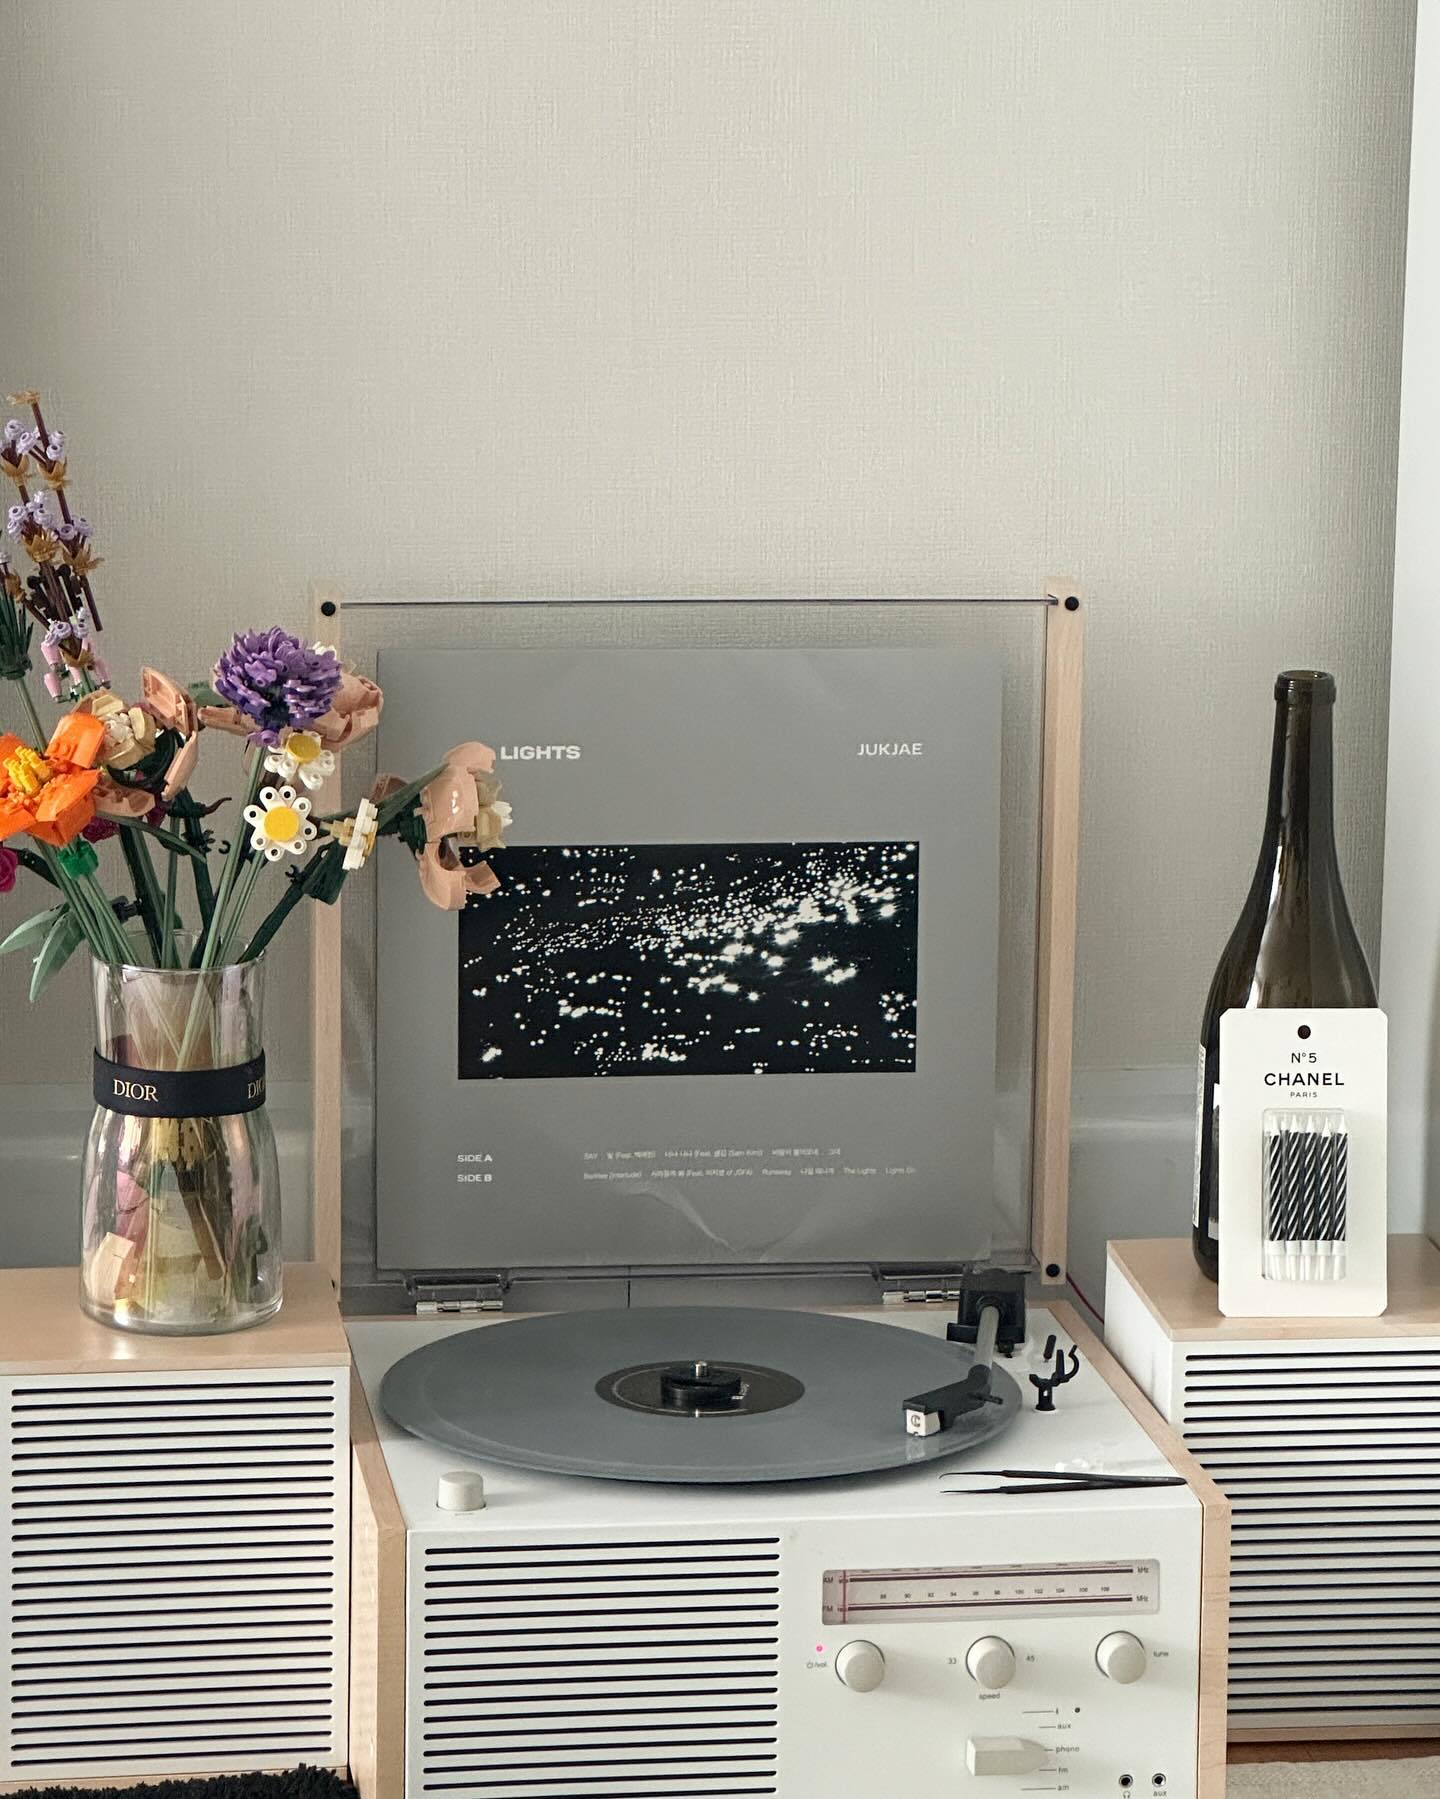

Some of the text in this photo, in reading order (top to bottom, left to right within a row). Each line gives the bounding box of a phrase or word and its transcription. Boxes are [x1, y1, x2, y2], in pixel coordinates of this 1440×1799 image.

[500, 745, 581, 760] LIGHTS
[857, 743, 923, 756] JUKJAE
[1264, 1072, 1345, 1086] CHANEL
[113, 1079, 159, 1102] DIOR
[247, 1079, 265, 1099] DIO
[457, 1154, 493, 1162] SIDE A
[457, 1174, 492, 1182] SIDE B
[979, 1692, 1001, 1700] speed
[1055, 1745, 1080, 1754] phono
